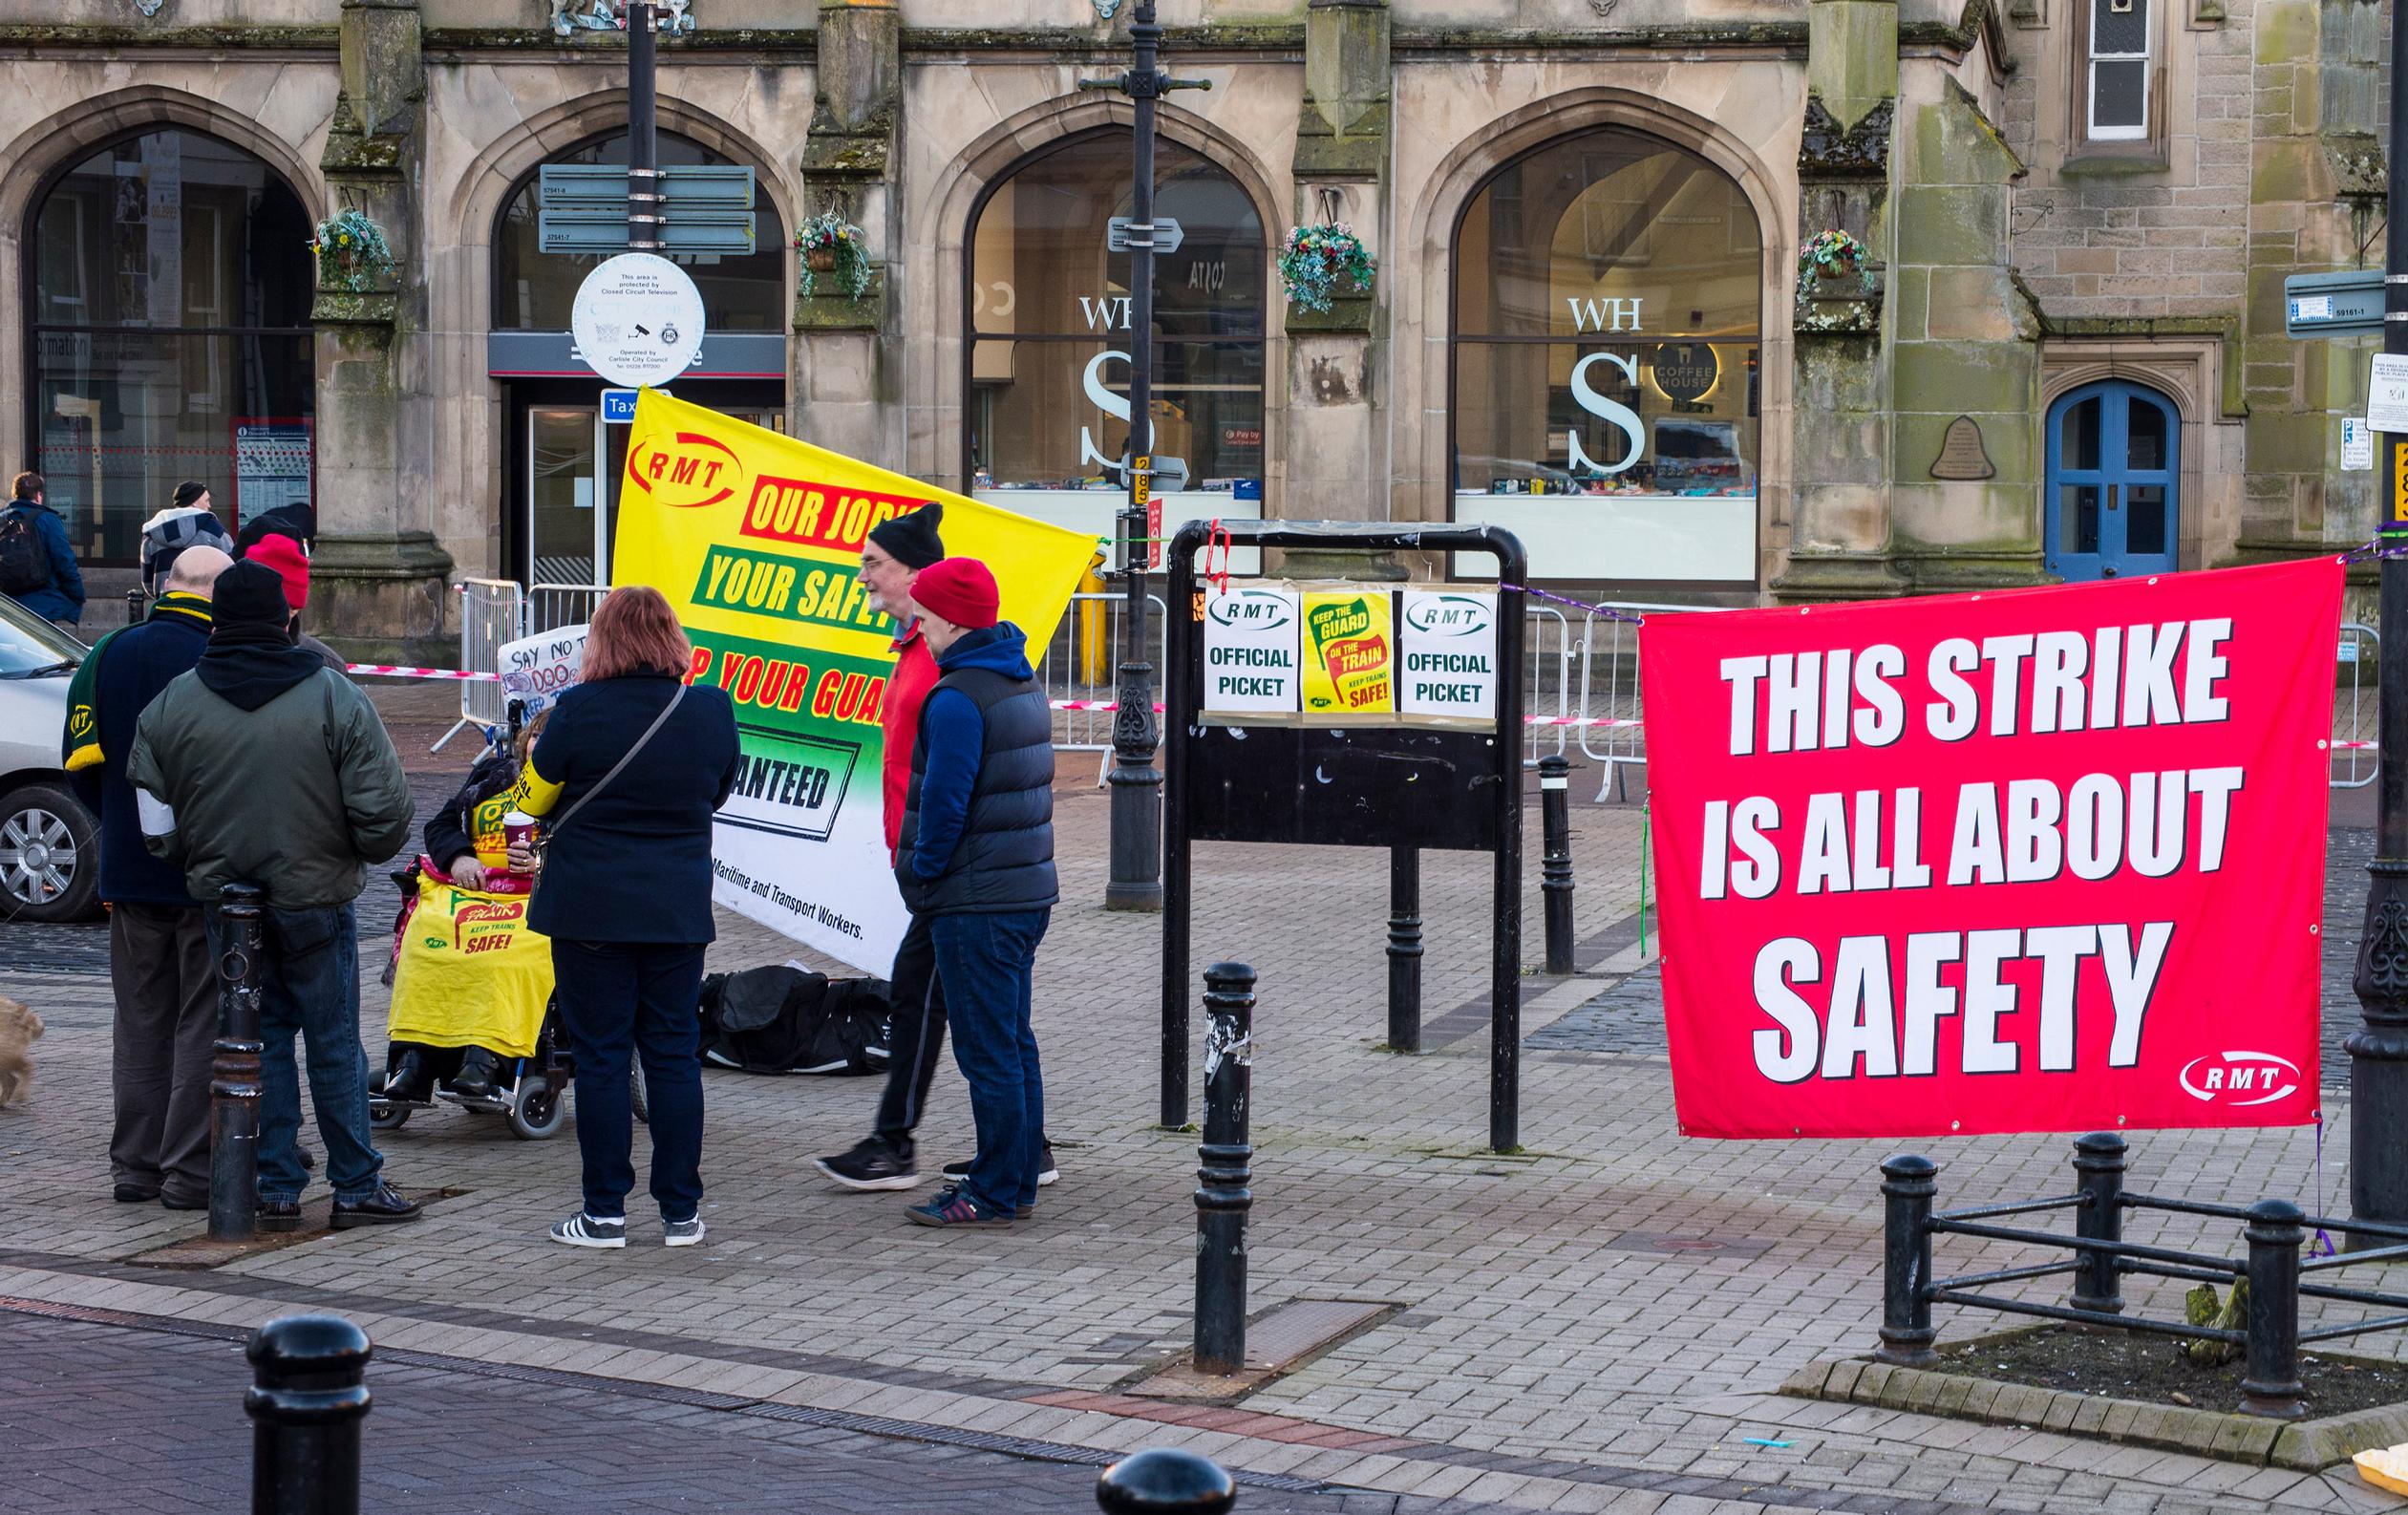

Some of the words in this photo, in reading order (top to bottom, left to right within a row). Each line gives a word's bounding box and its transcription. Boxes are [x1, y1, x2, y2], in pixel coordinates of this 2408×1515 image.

[1567, 297, 1644, 331] WH
[37, 333, 88, 357] ormation
[1657, 367, 1713, 377] COFFEE
[1661, 377, 1710, 388] HOUSE
[608, 397, 637, 414] Tax
[1081, 350, 1156, 469] S
[1568, 352, 1646, 474] S
[649, 452, 723, 489] RMT
[751, 483, 824, 538] OUR
[705, 554, 797, 611] YOUR
[1226, 603, 1278, 619] RMT
[1313, 610, 1334, 626] KEEP
[1335, 606, 1353, 619] THE
[1424, 609, 1477, 624] RMT
[1321, 612, 1367, 640] GUARD
[511, 647, 539, 672] SAY
[551, 640, 573, 660] NO
[1209, 647, 1293, 668] OFFICIAL
[1331, 647, 1341, 659] ON
[1343, 642, 1358, 654] THE
[1341, 646, 1382, 672] TRAIN
[1407, 652, 1492, 674] OFFICIAL
[718, 651, 810, 714] YOUR
[811, 669, 884, 727] GUA
[1219, 676, 1285, 696] PICKET
[1349, 678, 1364, 689] KEEP
[1366, 672, 1387, 684] TRAINS
[1416, 682, 1482, 703] PICKET
[1720, 644, 1906, 757] THIS
[1926, 617, 2232, 742] STRIKE
[1350, 682, 1388, 708] SAFE!
[732, 754, 830, 810] ANTEED
[1700, 795, 1782, 901] IS
[1797, 787, 1932, 895] ALL
[1947, 765, 2245, 888] ABOUT
[714, 857, 752, 890] Maritime
[751, 881, 772, 898] and
[772, 885, 816, 920] Transport
[818, 906, 863, 941] Workers.
[471, 925, 490, 933] KEEP
[465, 934, 513, 954] SAFE!
[1752, 921, 2177, 1085] SAFETY
[2205, 1068, 2280, 1090] RMT
